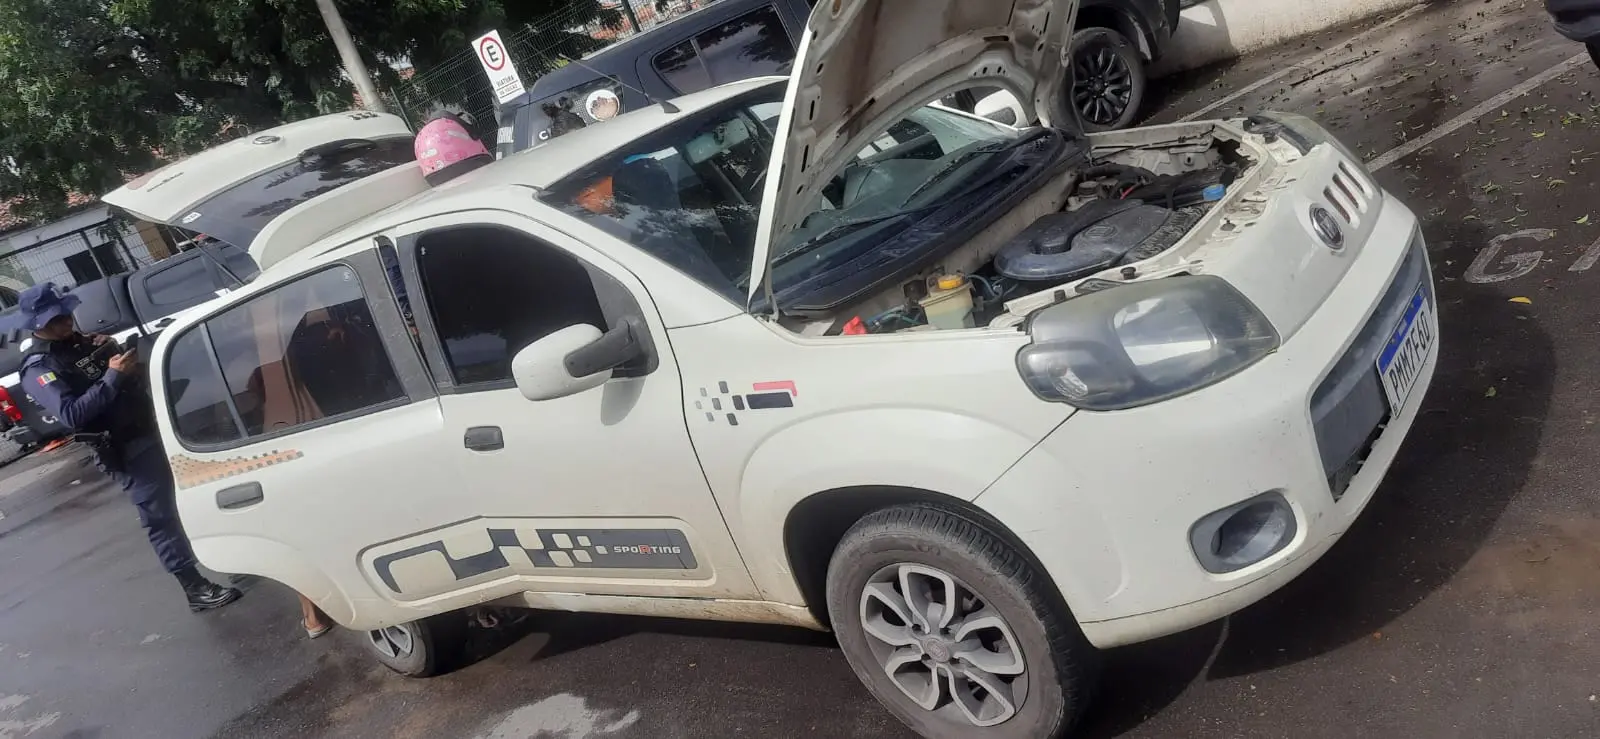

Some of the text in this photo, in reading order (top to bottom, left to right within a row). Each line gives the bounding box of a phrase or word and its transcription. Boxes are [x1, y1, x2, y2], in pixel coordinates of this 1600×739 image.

[486, 45, 499, 62] E
[1388, 312, 1430, 402] PMM7F60
[613, 544, 681, 555] SPORTING
